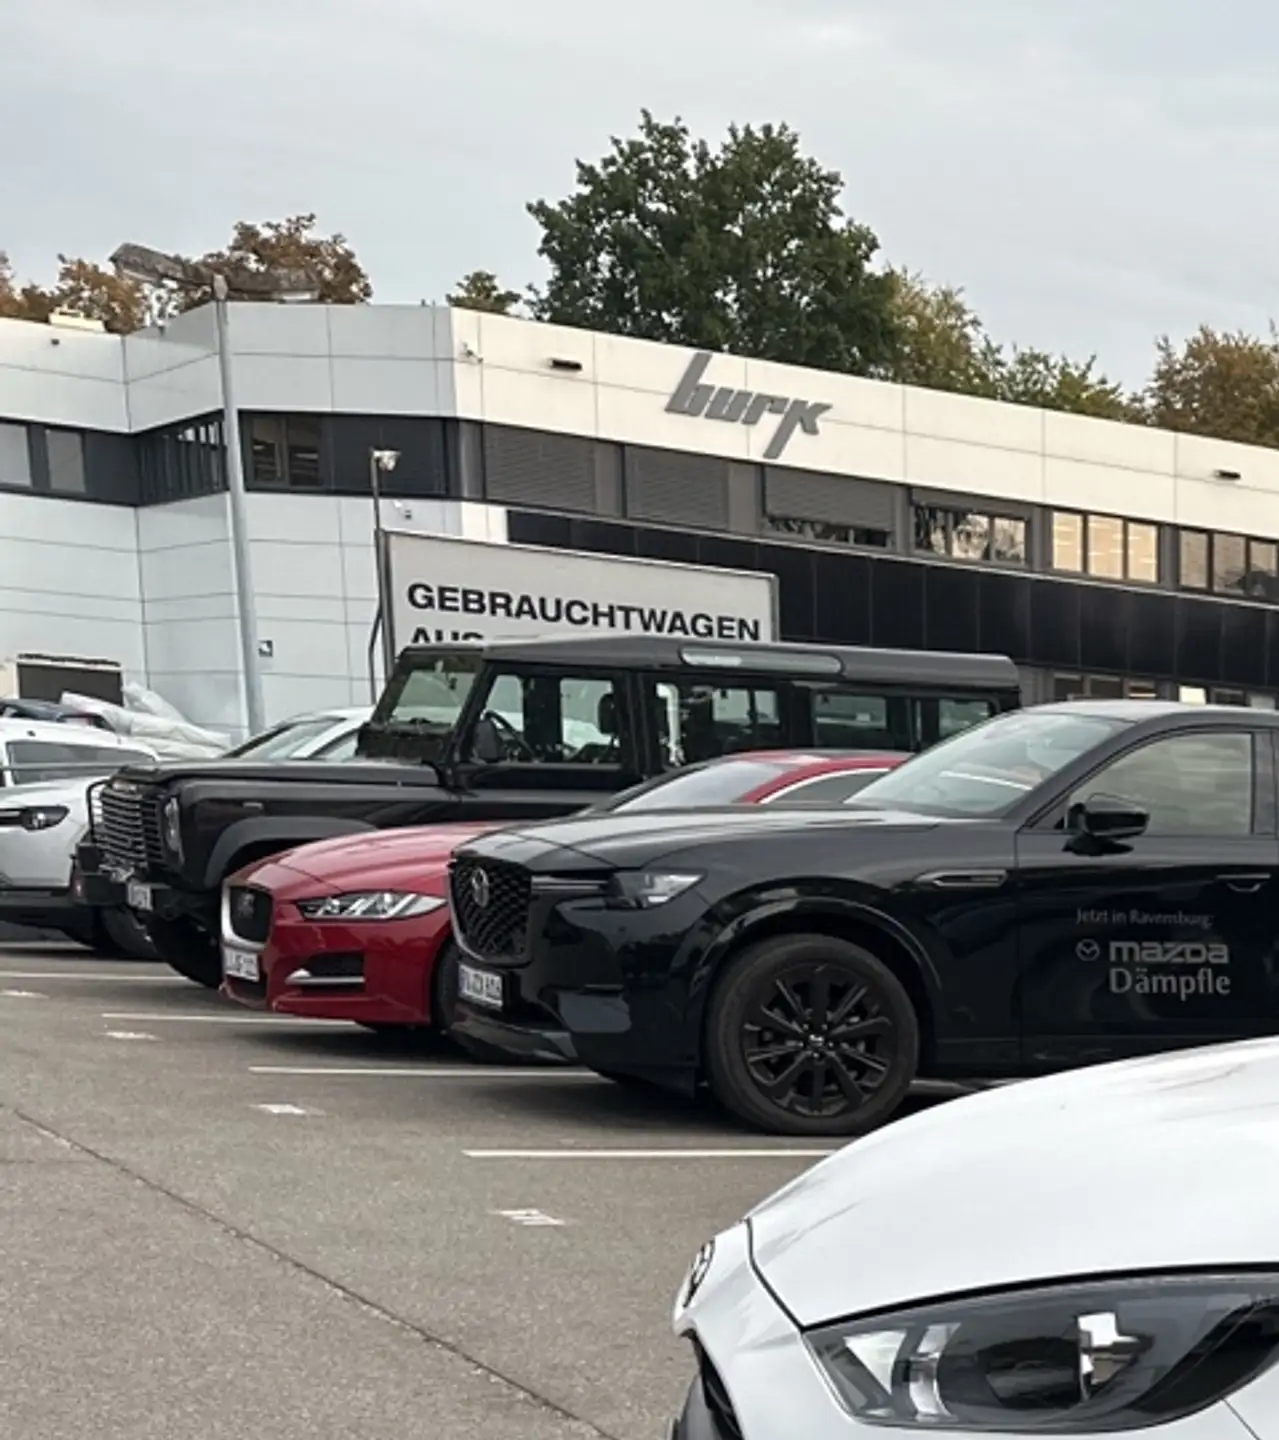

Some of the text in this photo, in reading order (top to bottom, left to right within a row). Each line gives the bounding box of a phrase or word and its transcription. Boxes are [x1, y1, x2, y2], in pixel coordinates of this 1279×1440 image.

[406, 582, 760, 641] GEBRAUCHTWAGEN
[1112, 908, 1127, 924] in
[1109, 966, 1231, 1002] Dämpfle
